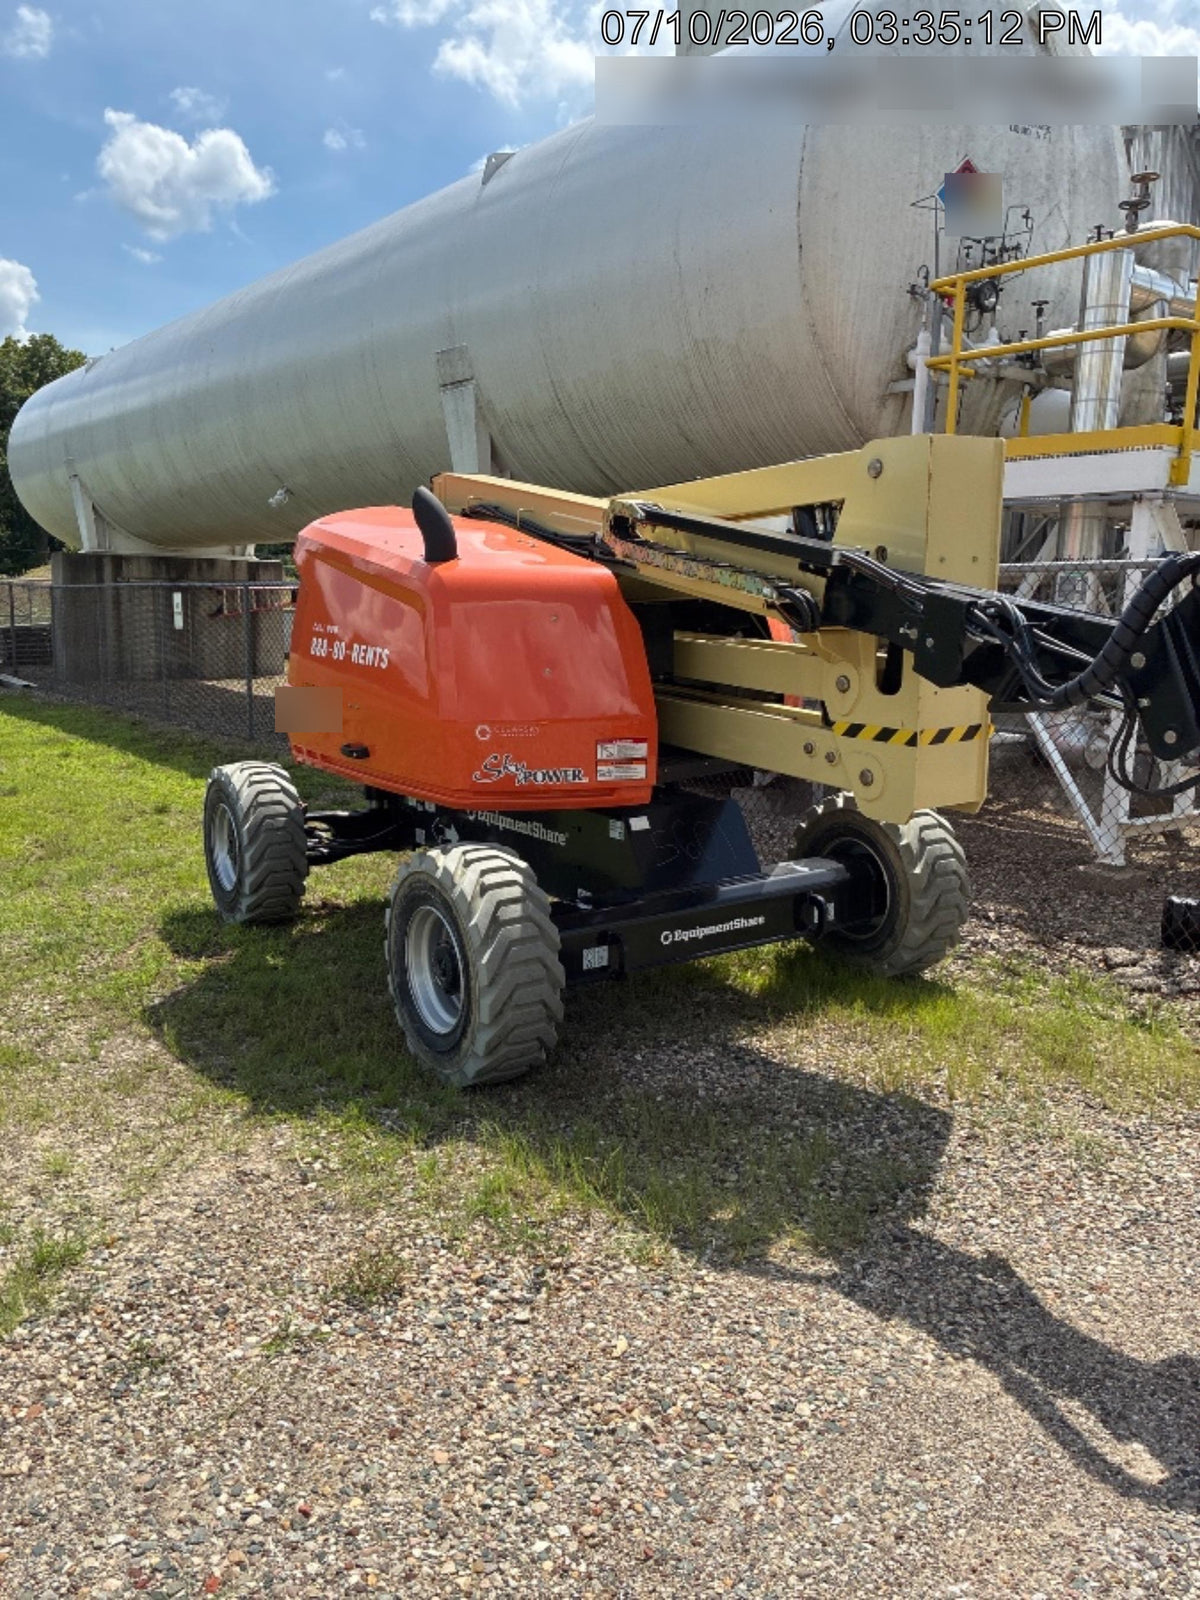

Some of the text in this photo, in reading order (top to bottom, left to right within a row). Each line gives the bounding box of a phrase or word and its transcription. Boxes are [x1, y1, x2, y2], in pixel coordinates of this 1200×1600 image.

[473, 753, 527, 786] Sky
[521, 767, 588, 784] POWER
[673, 915, 766, 942] EquipmentShare
